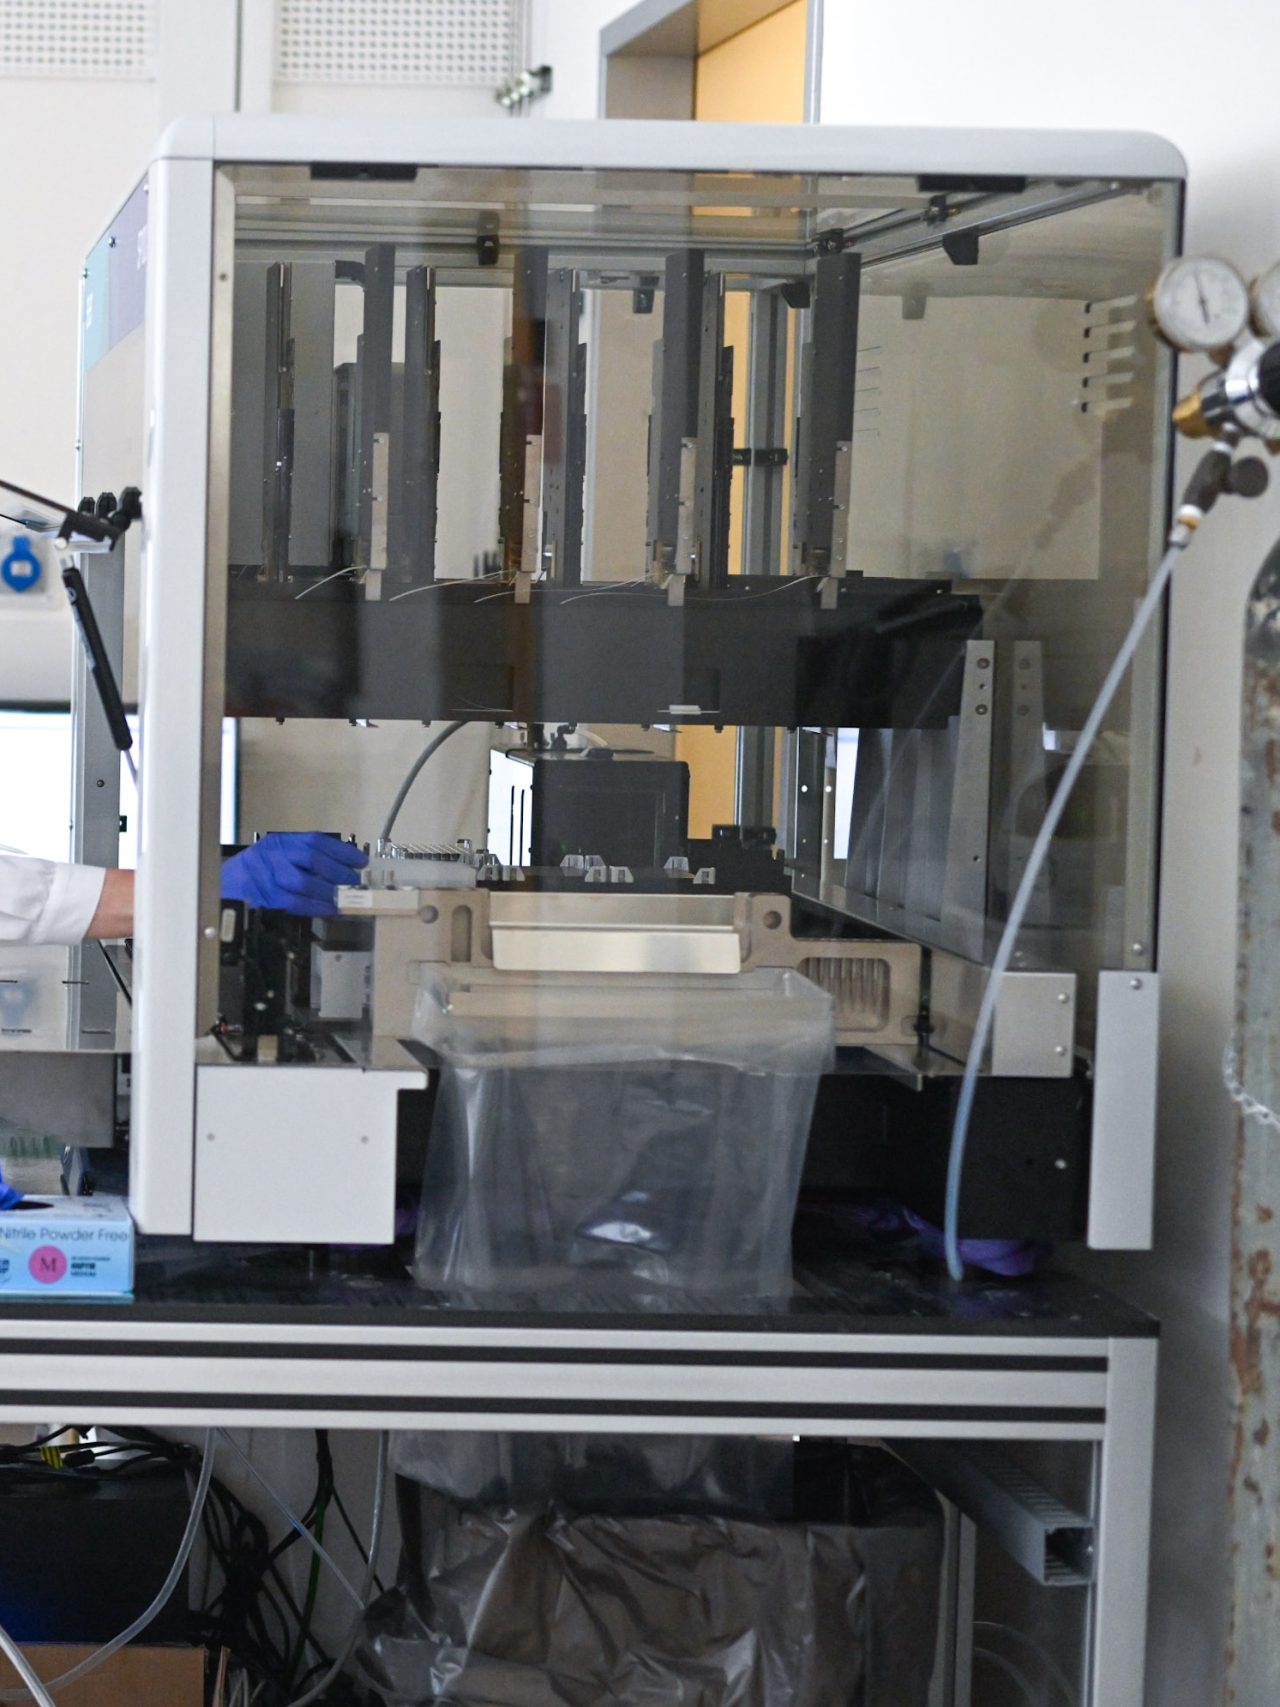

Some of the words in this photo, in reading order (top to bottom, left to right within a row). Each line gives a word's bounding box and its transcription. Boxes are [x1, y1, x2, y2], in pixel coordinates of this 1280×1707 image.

[40, 1227, 95, 1241] Powder
[98, 1228, 128, 1241] Free
[40, 1256, 57, 1273] M
